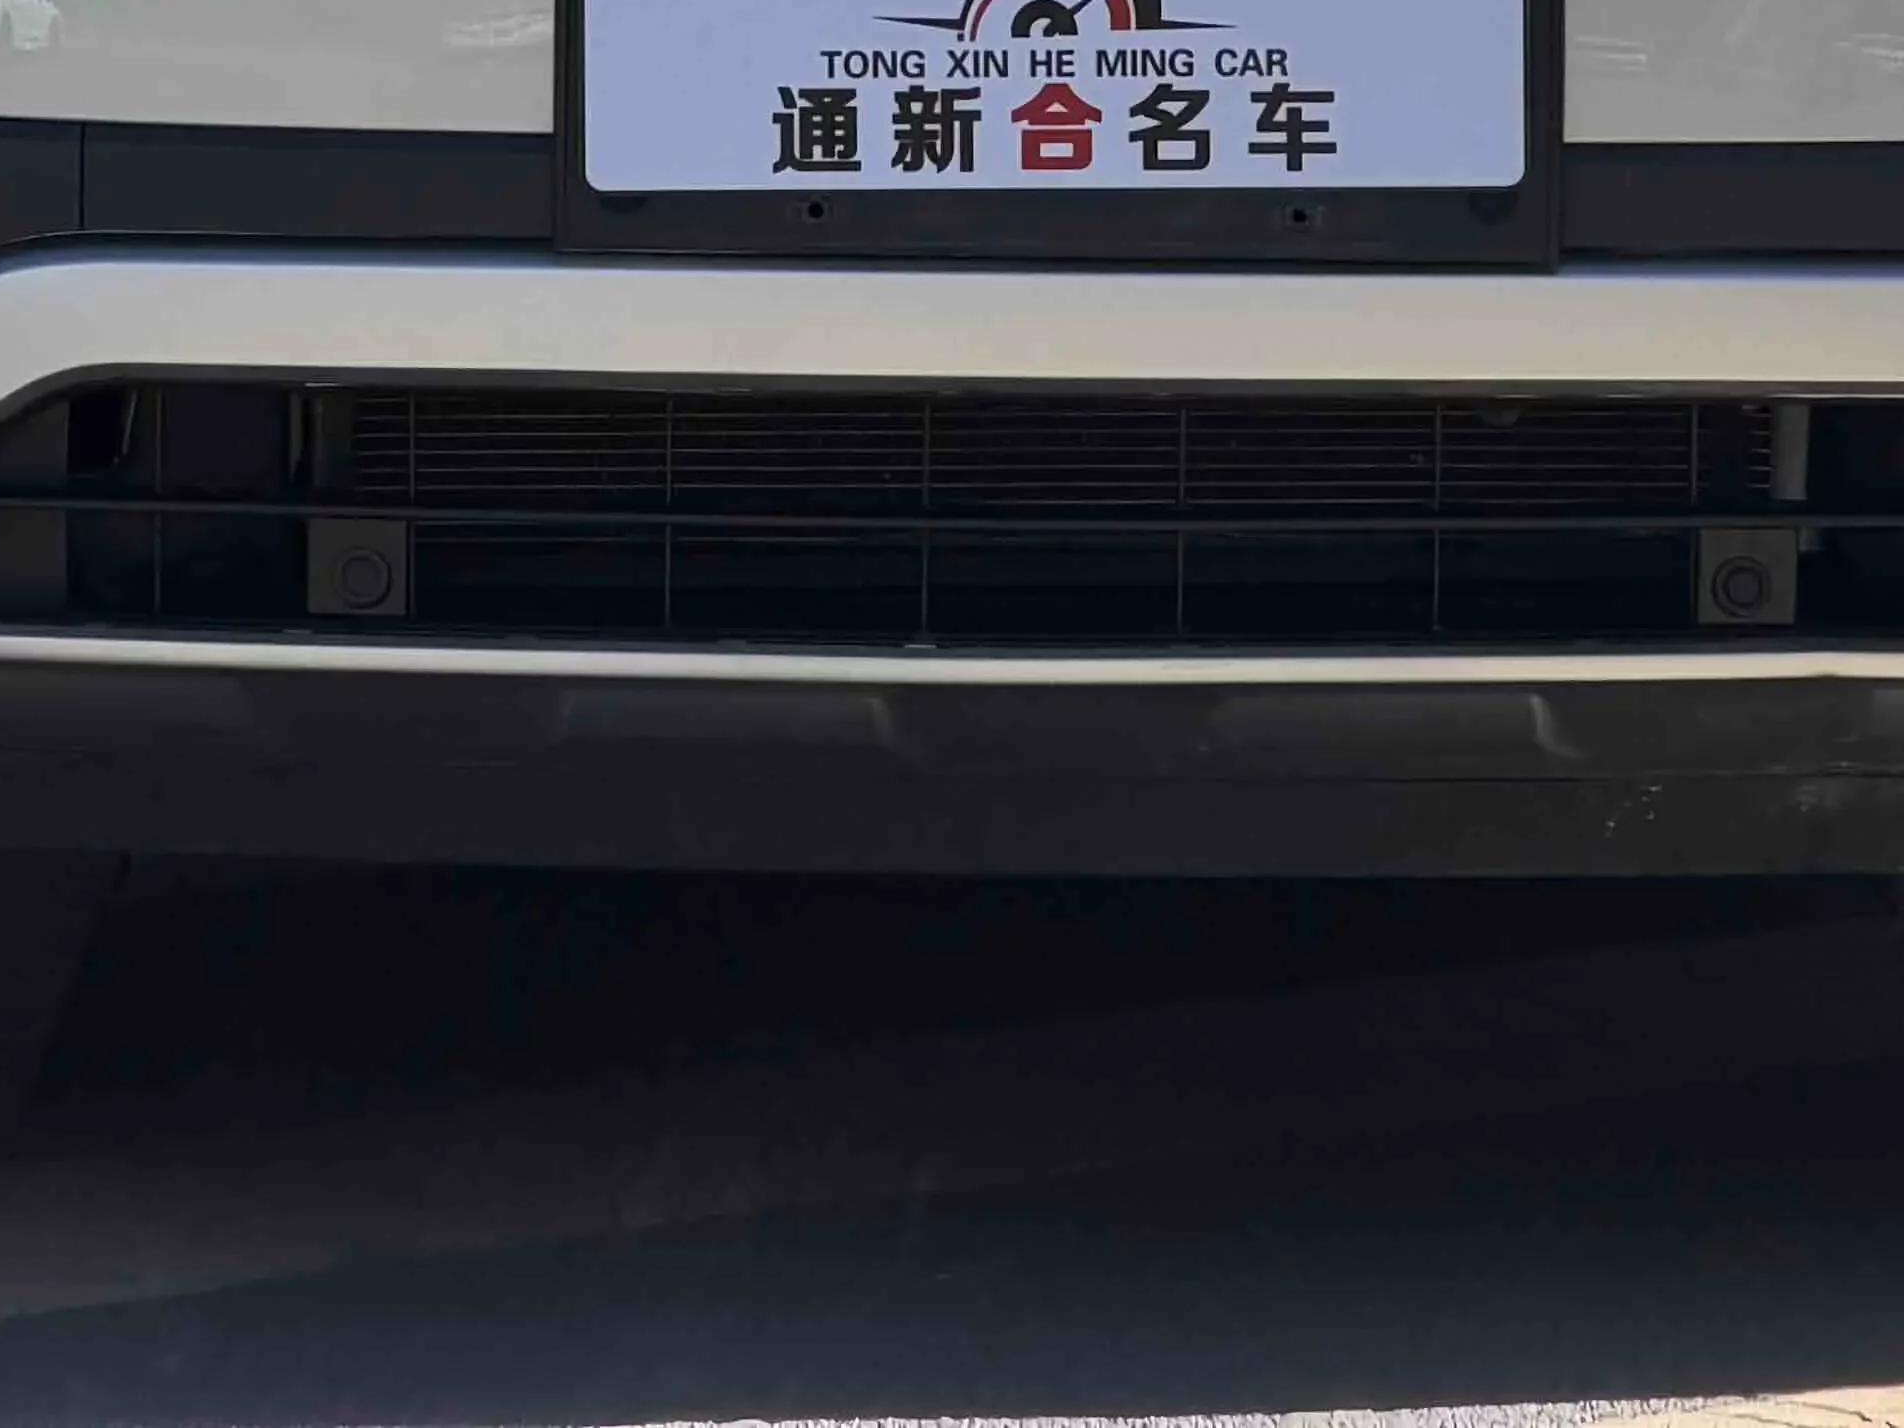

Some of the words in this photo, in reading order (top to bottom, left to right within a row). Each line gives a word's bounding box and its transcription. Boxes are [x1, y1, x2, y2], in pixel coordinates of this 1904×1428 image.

[819, 49, 926, 80] TONG
[946, 49, 1009, 79] XIN
[1029, 48, 1076, 78] HE
[1095, 48, 1195, 78] MING
[1214, 47, 1289, 78] CAR
[771, 82, 1338, 175] 通新合名车
